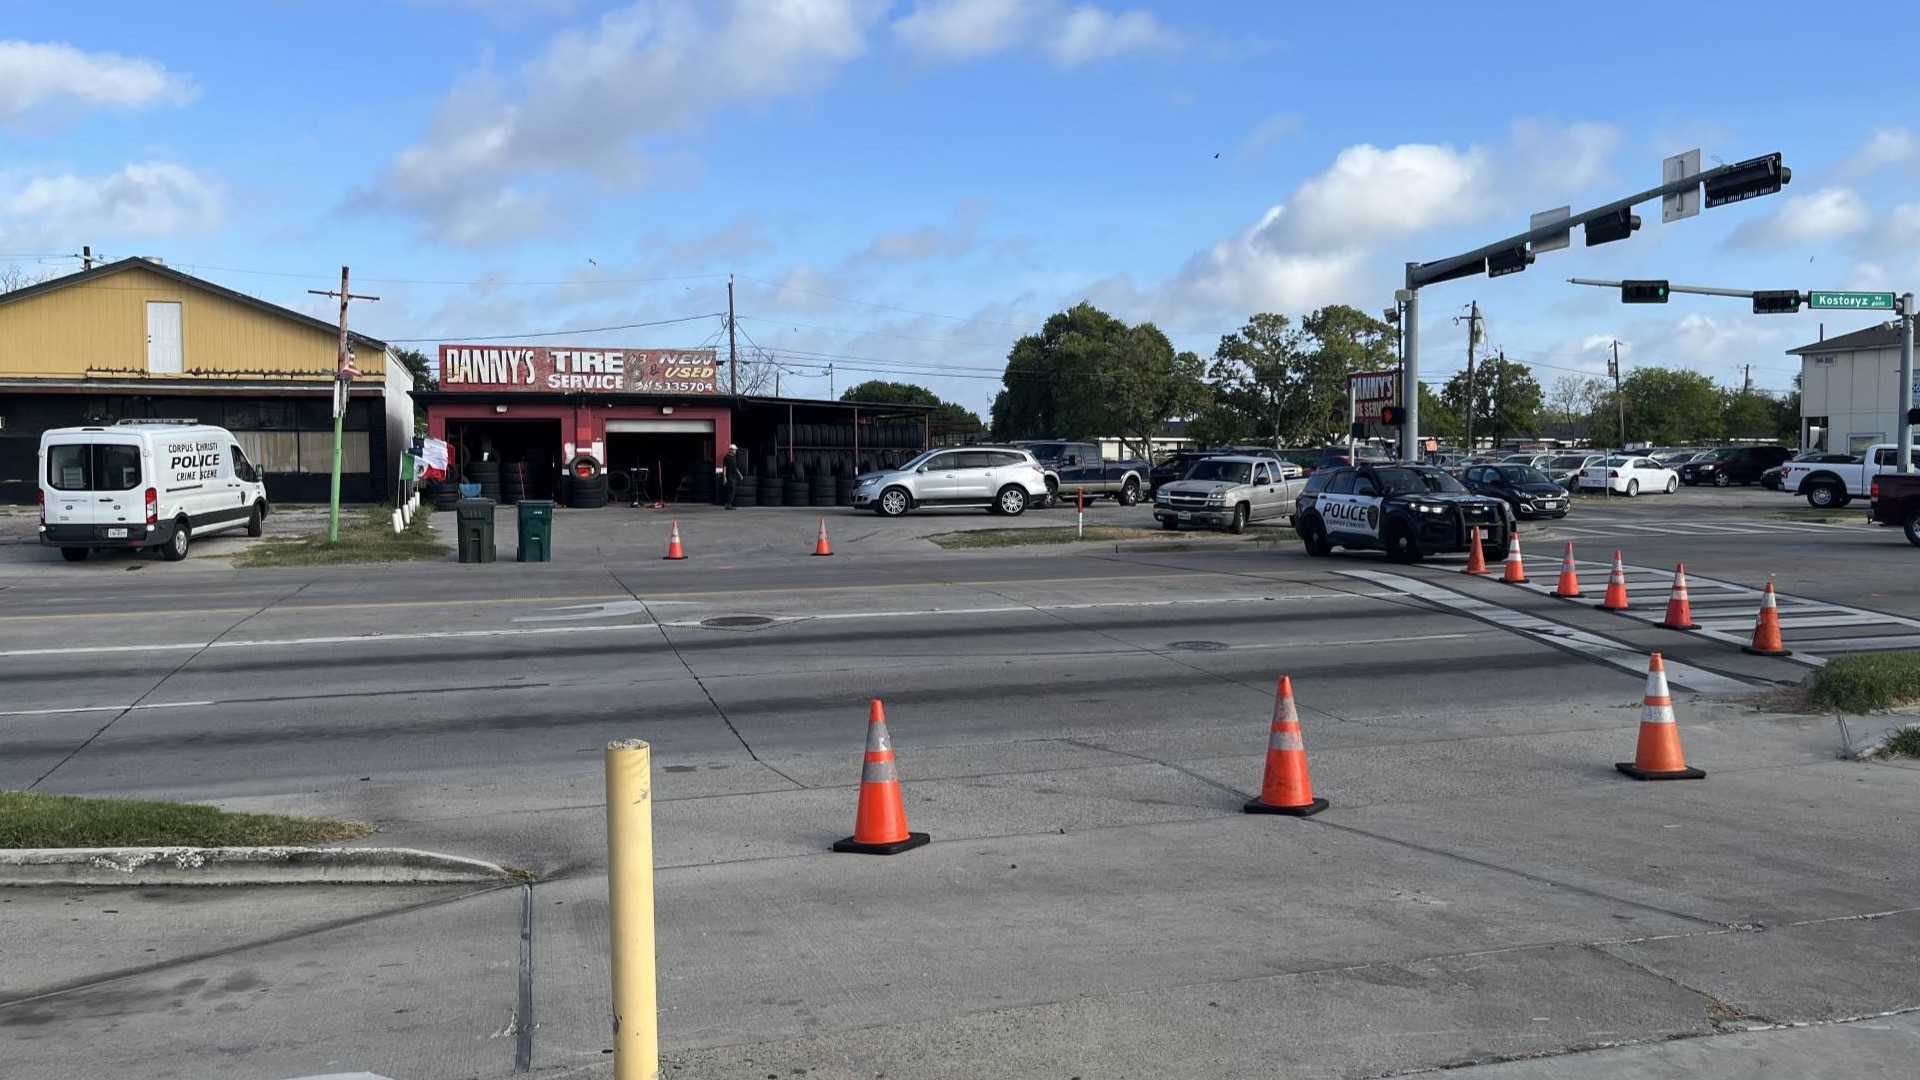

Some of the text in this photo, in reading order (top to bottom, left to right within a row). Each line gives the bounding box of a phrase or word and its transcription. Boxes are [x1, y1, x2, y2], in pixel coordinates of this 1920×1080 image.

[1819, 295, 1868, 307] Kostoryz
[550, 351, 624, 373] TIRE
[659, 353, 713, 365] NEW
[446, 349, 536, 384] DANNY'S
[664, 367, 713, 378] USED
[548, 374, 624, 389] SERVICE
[168, 442, 217, 453] CORPUS CHRISTI
[171, 453, 219, 470] POLICE
[176, 469, 217, 481] CRIME SCENE
[1322, 502, 1367, 521] POLICE
